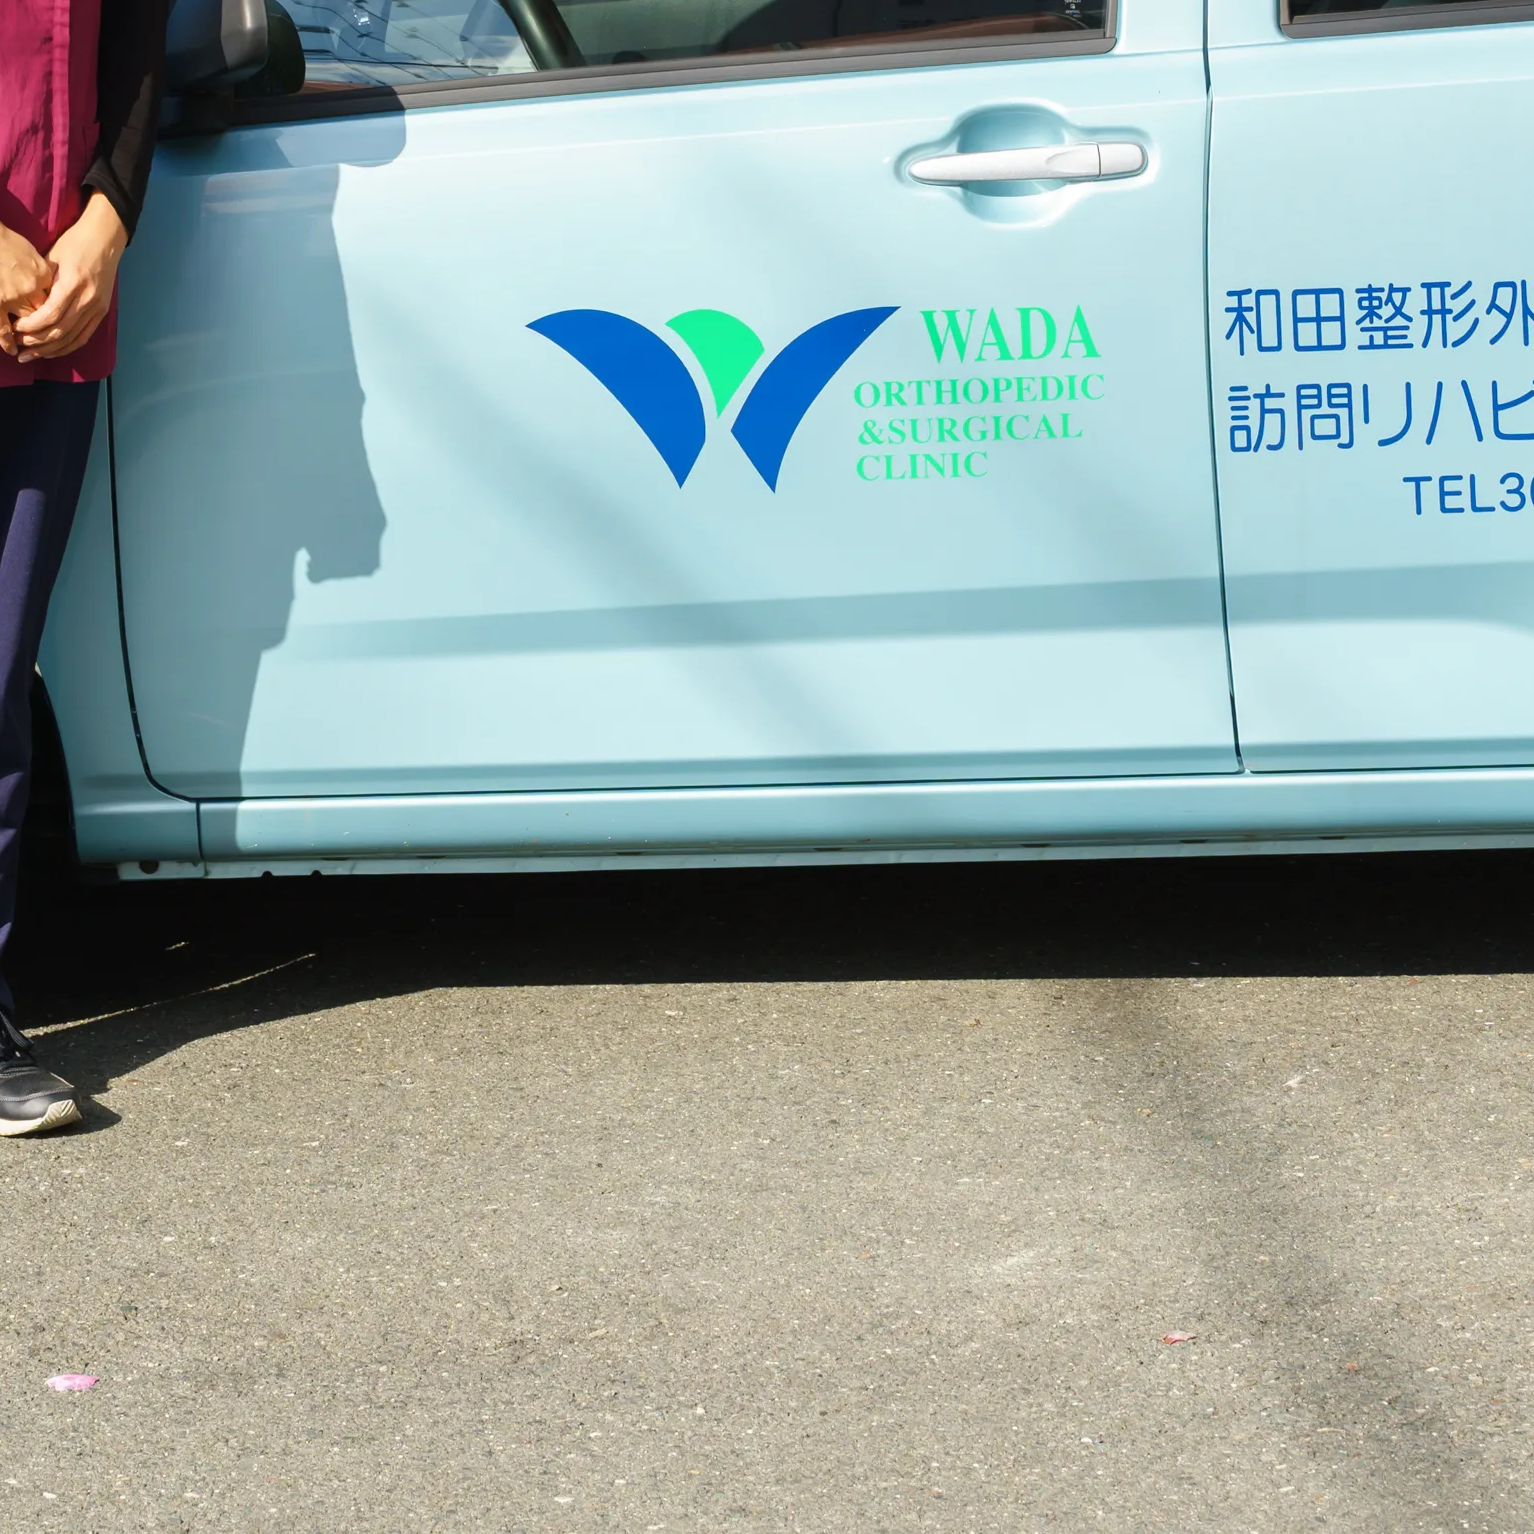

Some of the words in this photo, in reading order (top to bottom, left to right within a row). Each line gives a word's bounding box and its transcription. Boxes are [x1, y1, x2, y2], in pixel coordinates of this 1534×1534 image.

[918, 303, 1103, 365] WADA
[853, 372, 1106, 409] ORTHOPEDIC
[857, 412, 1084, 446] &SURGICAL
[855, 450, 989, 482] CLINIC
